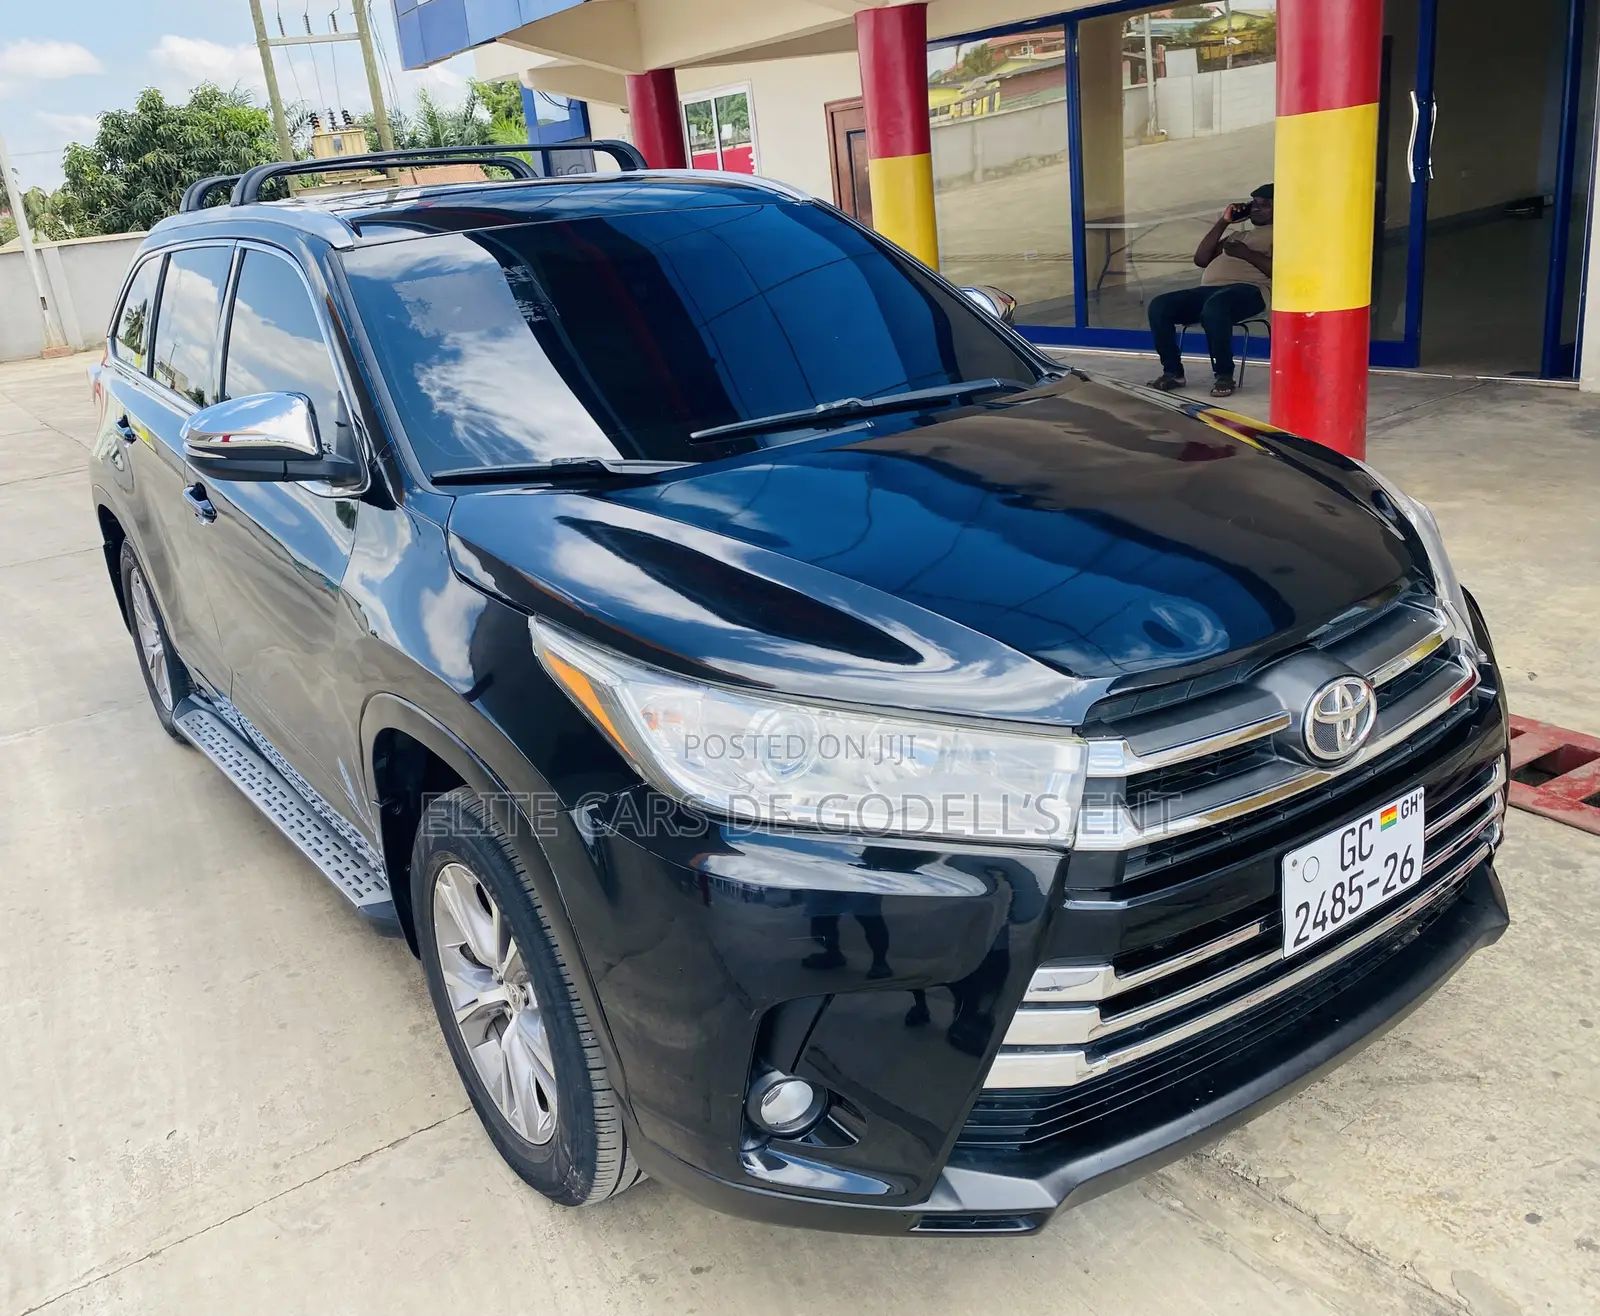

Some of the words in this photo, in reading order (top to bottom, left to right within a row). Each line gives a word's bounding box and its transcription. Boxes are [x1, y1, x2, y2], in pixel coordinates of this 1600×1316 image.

[1401, 793, 1418, 820] GH
[1340, 818, 1374, 872] GC
[1293, 843, 1415, 948] 2485-26
